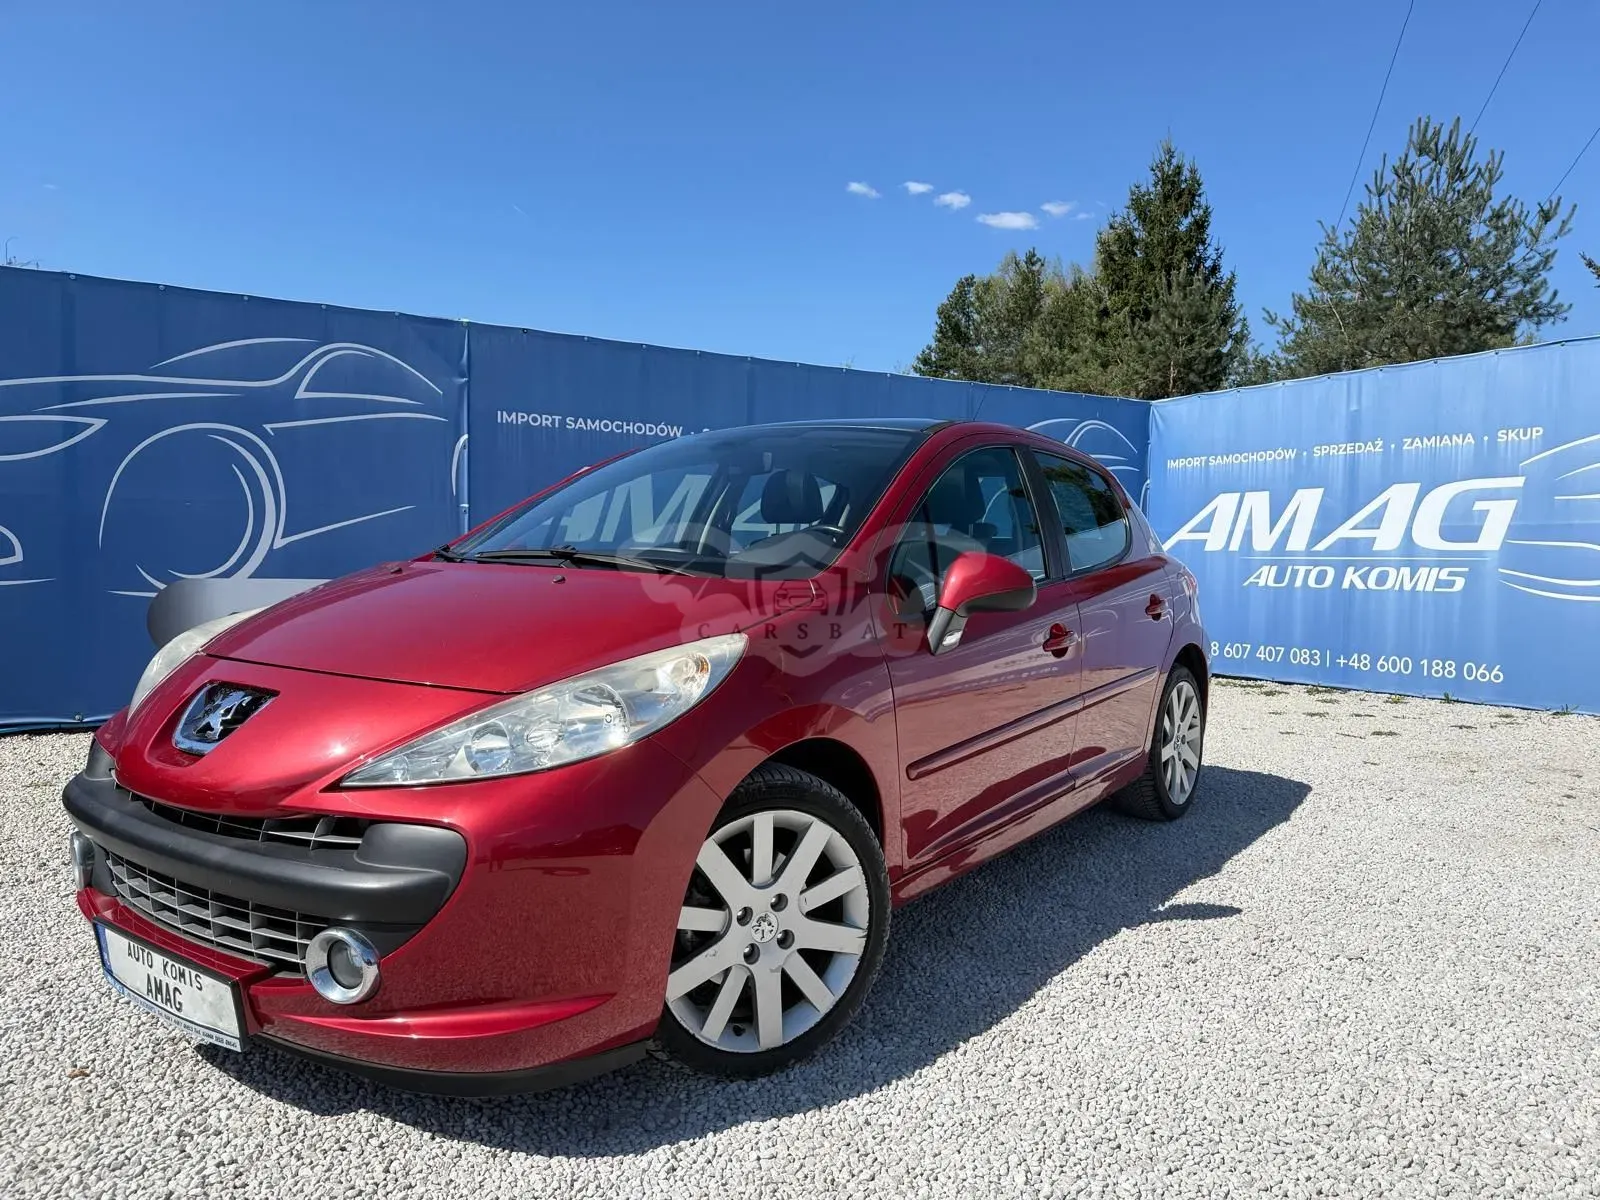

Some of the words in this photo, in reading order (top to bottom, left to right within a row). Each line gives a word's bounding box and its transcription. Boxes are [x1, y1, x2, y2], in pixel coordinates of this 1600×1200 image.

[496, 410, 562, 428] IMPORT
[565, 416, 683, 438] SAMOCHODÓW
[1167, 456, 1207, 469] IMPORT
[1208, 448, 1297, 466] SAMOCHODÓW
[1312, 438, 1383, 457] SPRZEDAŻ
[1402, 433, 1475, 450] ZAMIANA
[1496, 427, 1543, 442] SKUP
[1161, 476, 1525, 552] AMAG
[1243, 565, 1335, 588] AUTO
[1341, 566, 1469, 592] KOMIS
[1223, 643, 1251, 659] 607
[1255, 646, 1285, 663] 407
[1289, 647, 1320, 666] 083
[1336, 652, 1371, 672] +48
[1376, 655, 1412, 674] 600
[1420, 658, 1456, 679] 188
[1463, 662, 1504, 683] 066
[127, 941, 154, 969] AUTO
[162, 959, 203, 991] KOMIS
[146, 973, 183, 1013] AMAG
